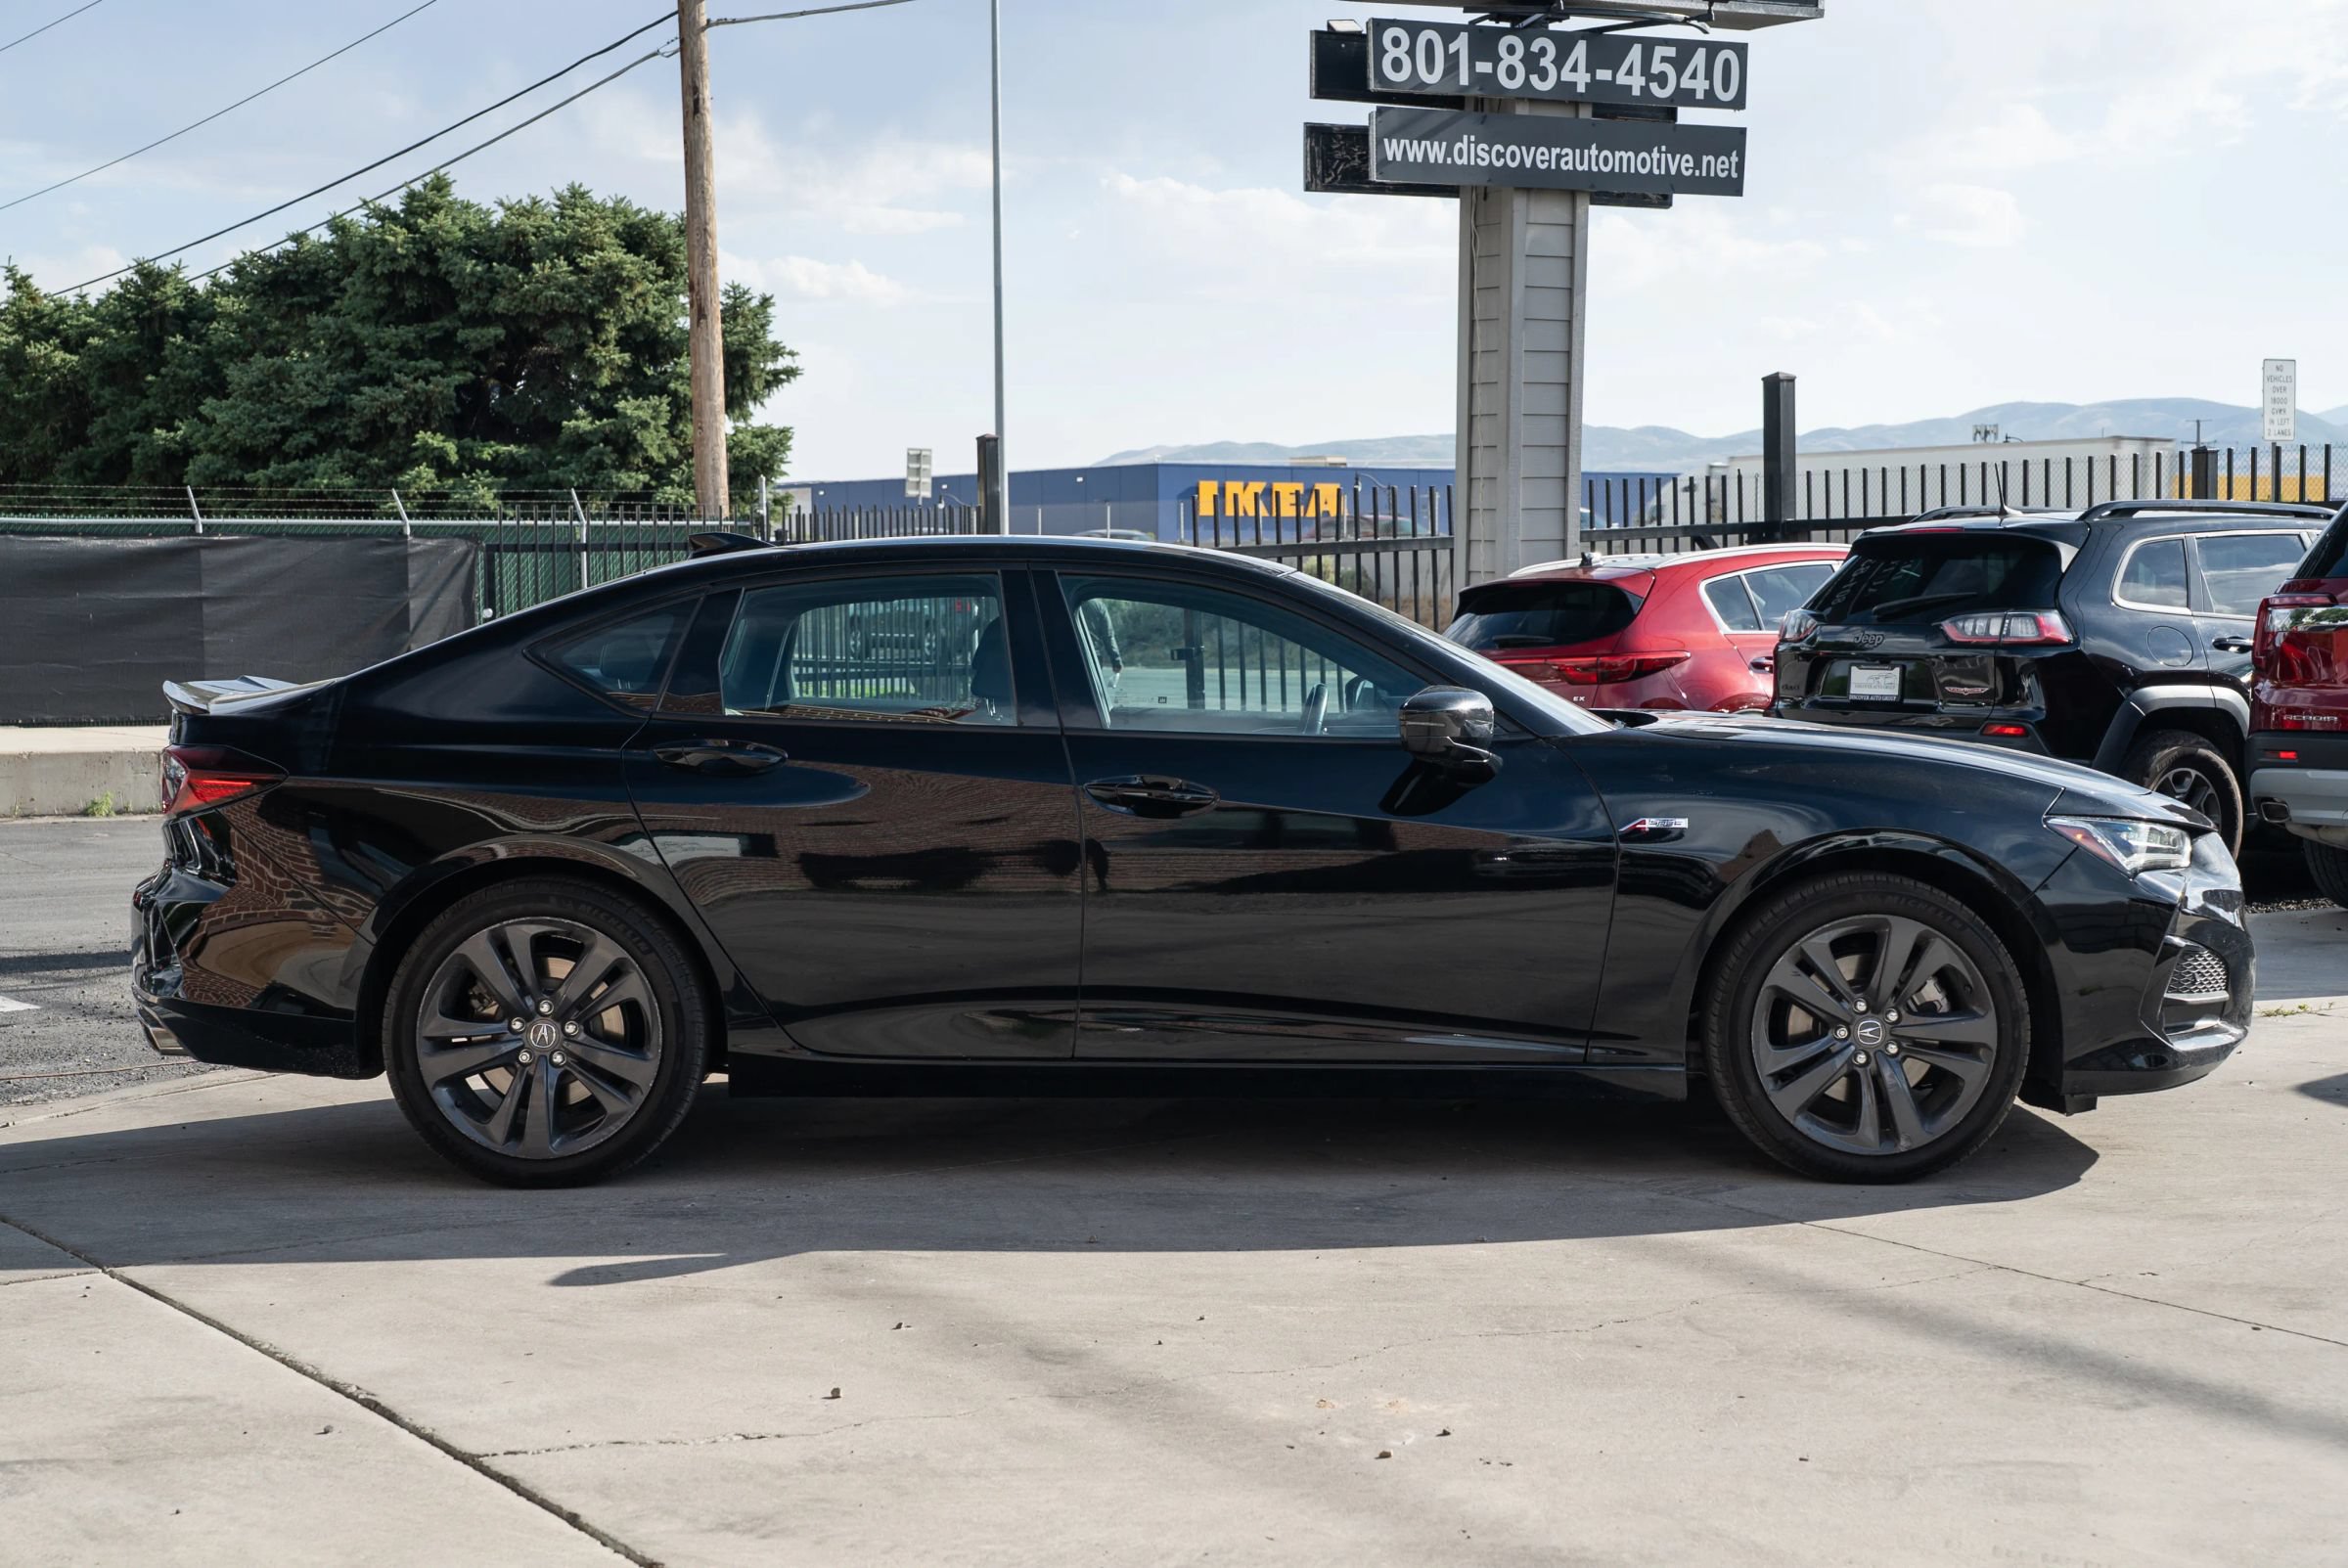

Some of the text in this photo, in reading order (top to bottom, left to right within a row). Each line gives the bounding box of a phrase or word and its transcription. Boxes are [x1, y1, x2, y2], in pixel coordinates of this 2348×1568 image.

[1380, 25, 1740, 103] 801-834-4540
[1382, 134, 1739, 180] www.discoverautomotive.net
[1198, 480, 1348, 517] IKEA
[1853, 631, 1885, 650] Jeep
